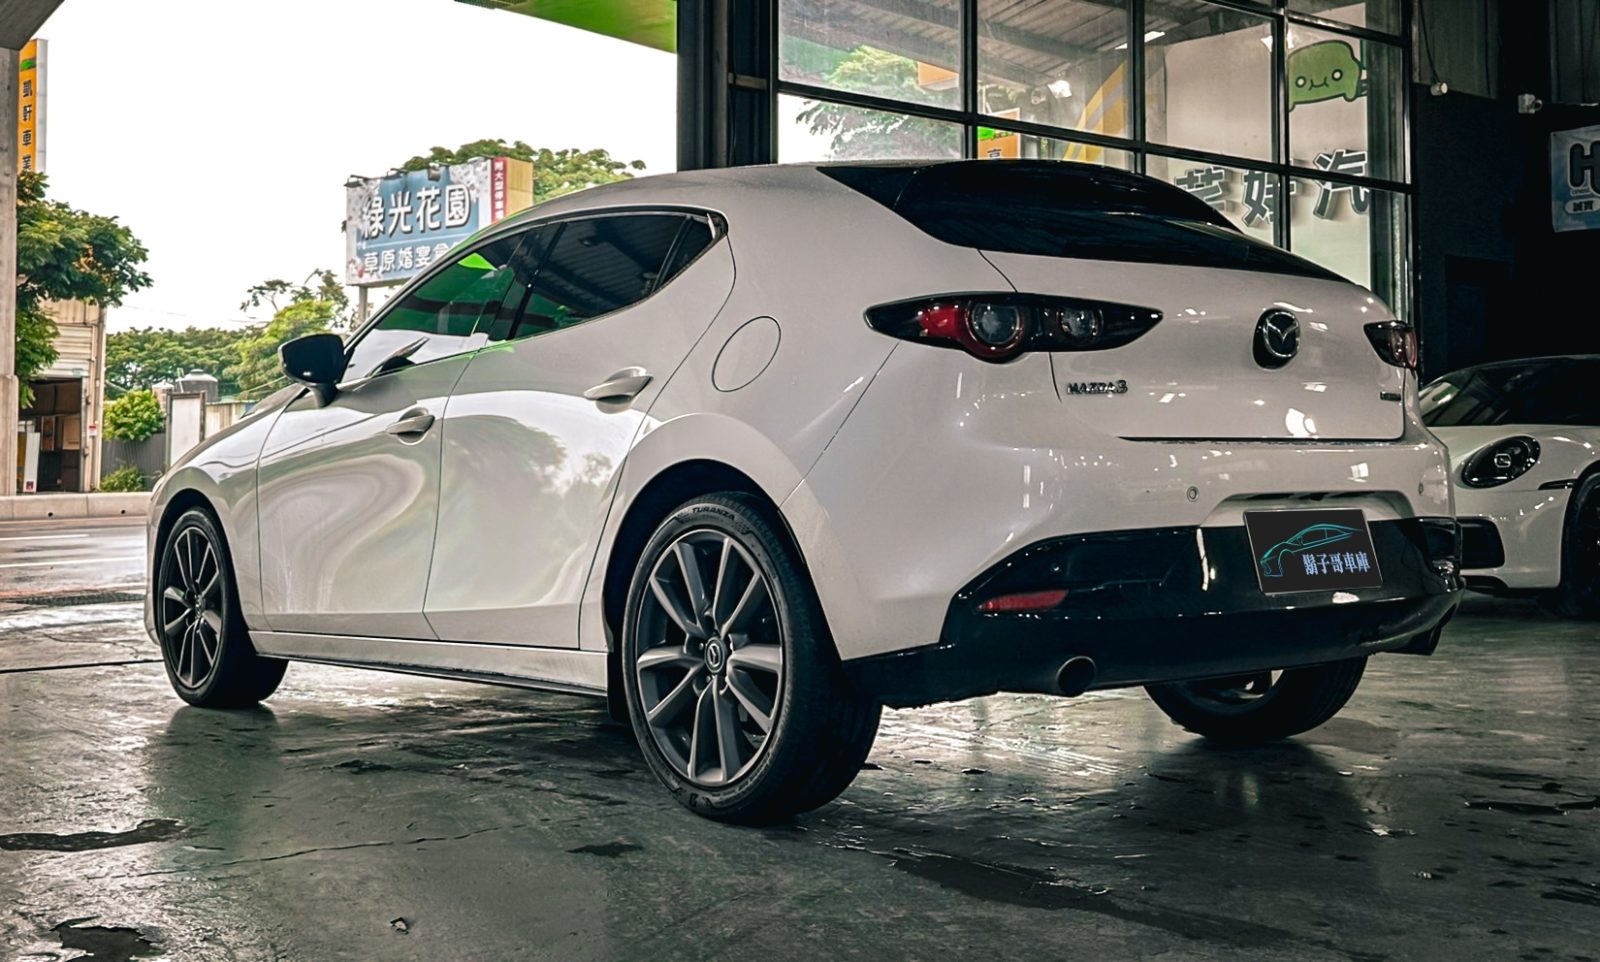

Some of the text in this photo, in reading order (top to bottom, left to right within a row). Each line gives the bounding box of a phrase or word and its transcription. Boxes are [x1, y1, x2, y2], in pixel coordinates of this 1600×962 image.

[362, 184, 472, 238] 綠光花園
[363, 242, 459, 276] 草原婚宴會
[692, 507, 736, 521] TURANZA
